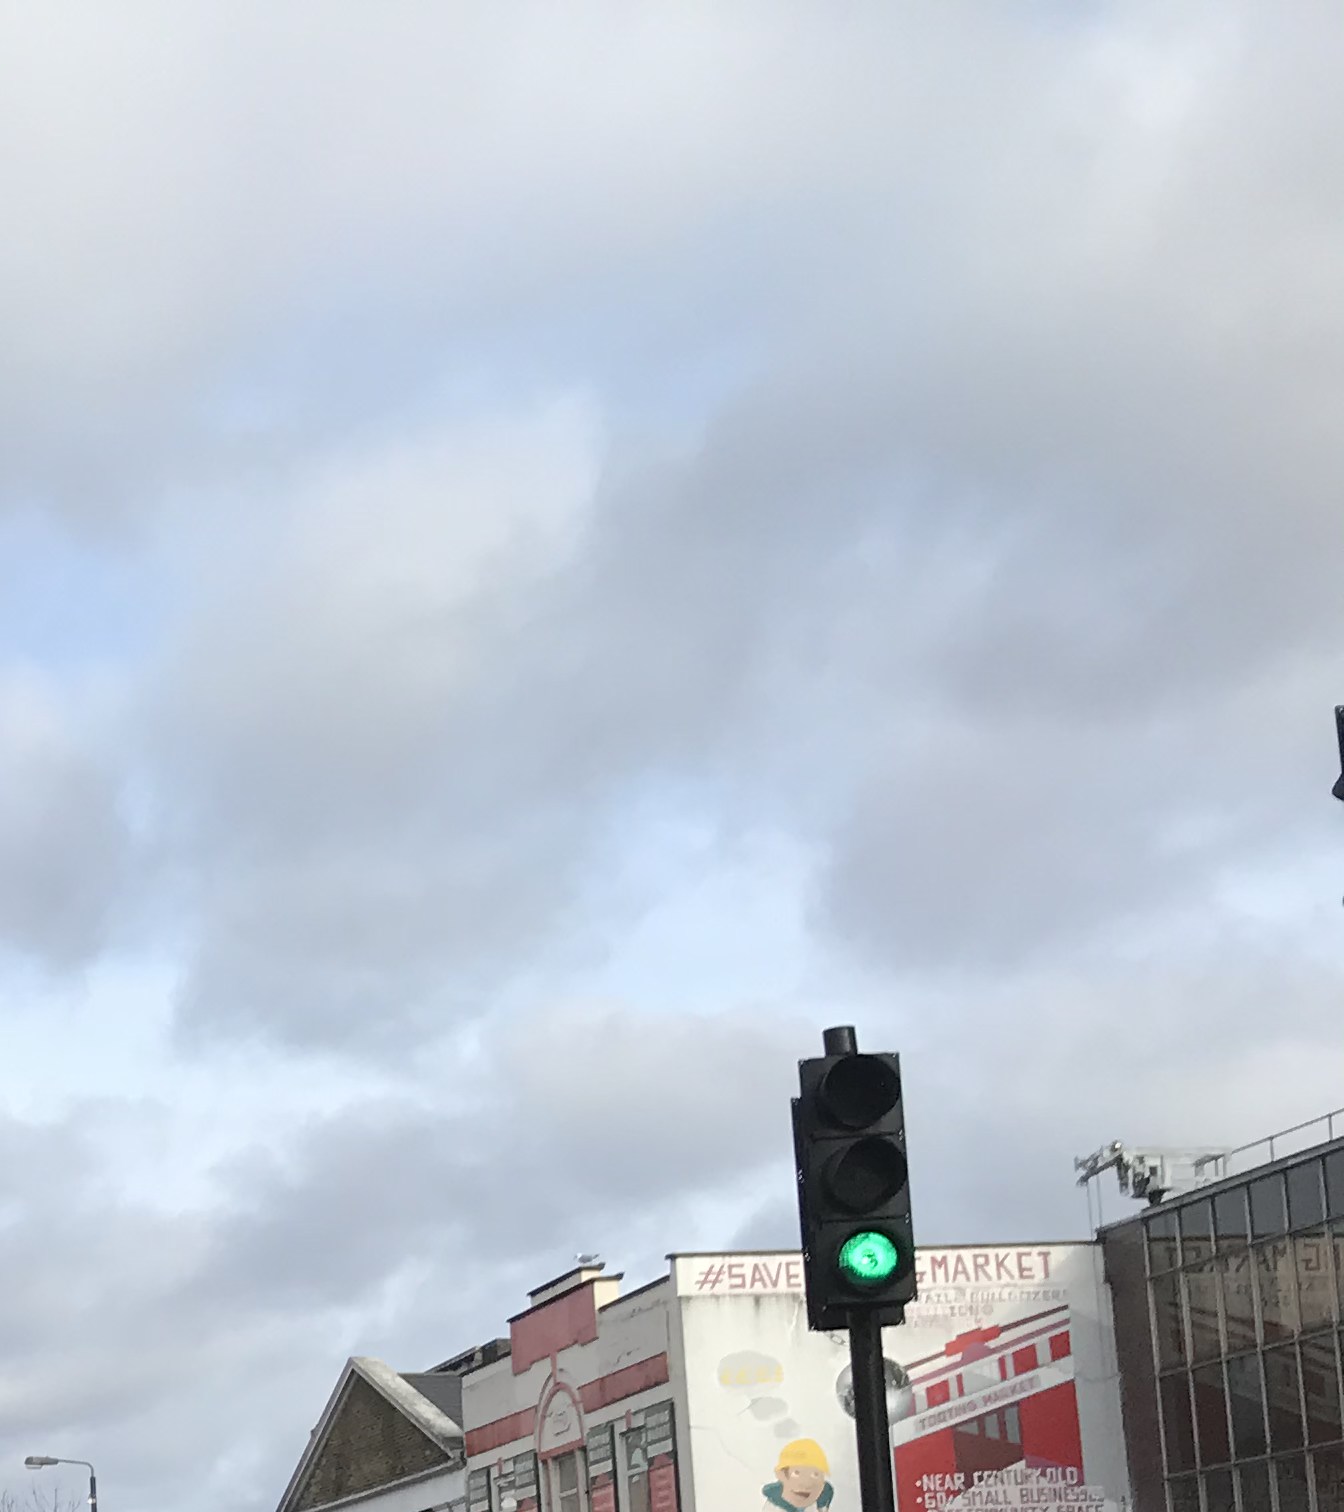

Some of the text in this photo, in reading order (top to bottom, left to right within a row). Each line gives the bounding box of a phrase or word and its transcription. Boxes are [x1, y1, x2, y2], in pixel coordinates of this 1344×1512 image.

[695, 1260, 802, 1290] #SAVE
[923, 1471, 965, 1492] NEAR
[963, 1488, 1011, 1507] SMALL
